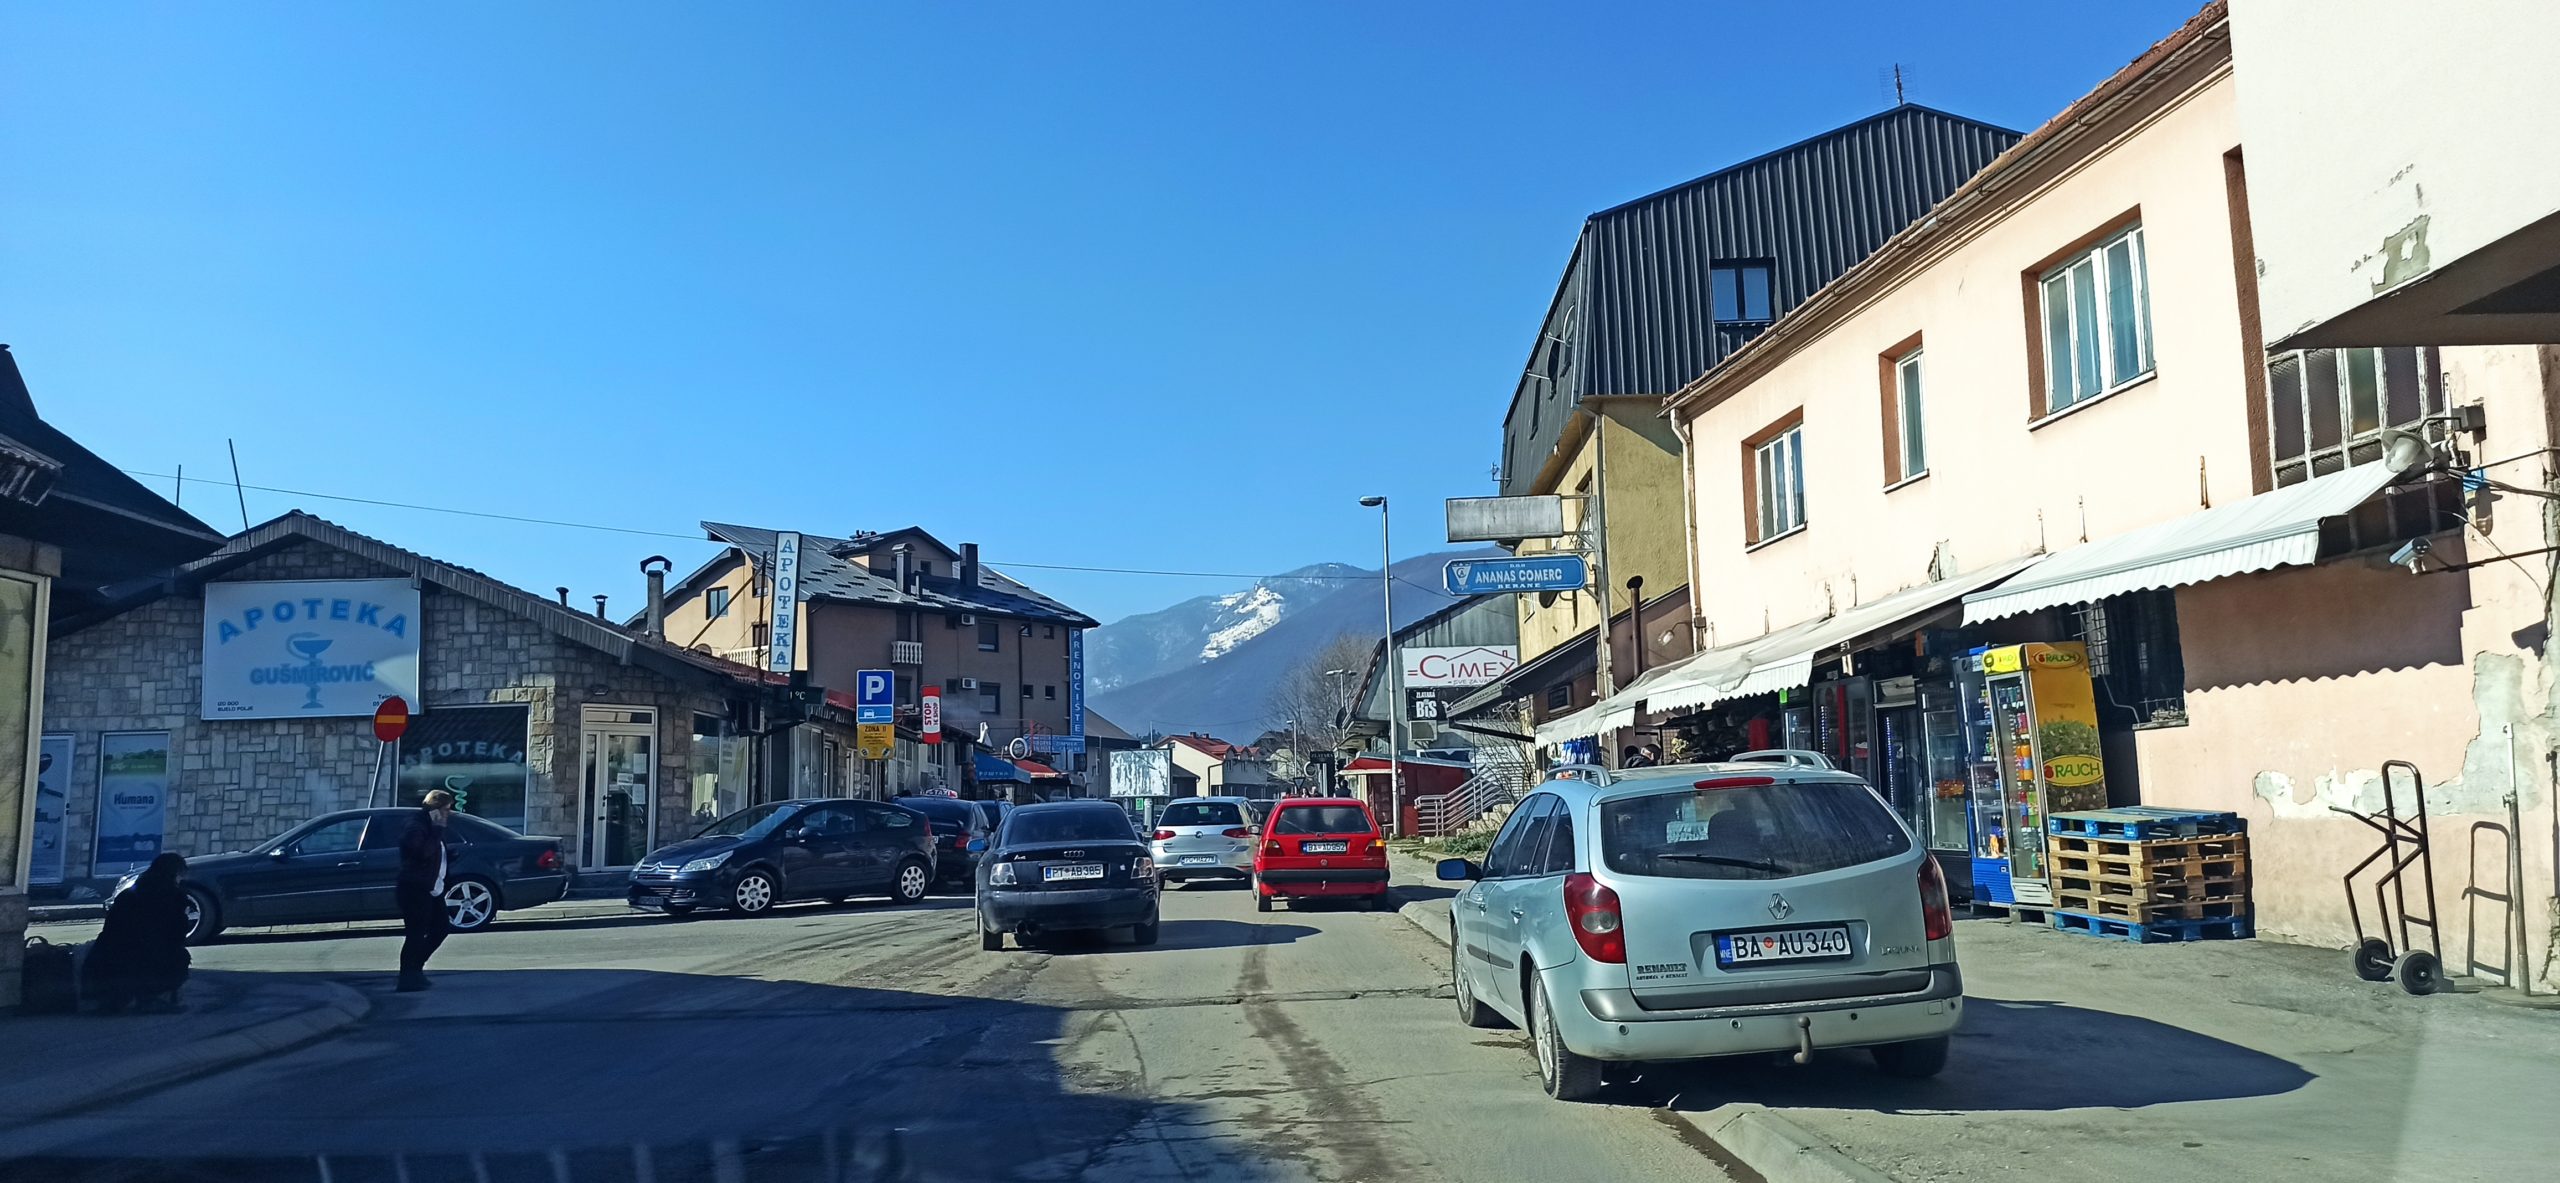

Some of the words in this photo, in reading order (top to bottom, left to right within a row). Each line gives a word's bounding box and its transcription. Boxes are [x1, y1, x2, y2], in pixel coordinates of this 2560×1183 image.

[1475, 571, 1516, 583] ANANAS
[1519, 568, 1562, 581] COMERC
[773, 539, 795, 665] APOTEKA
[218, 598, 407, 645] APOTEKA
[1420, 655, 1515, 679] CIMEX
[2045, 652, 2076, 662] RAUCH
[250, 660, 375, 685] GUŠMIROVIĆ
[866, 675, 885, 701] P
[924, 703, 932, 726] STOP
[404, 741, 523, 771] APOTEKA
[2055, 763, 2101, 777] RAUCH
[114, 792, 154, 805] Humana
[1053, 867, 1064, 877] PT
[1734, 935, 1763, 958] BA
[1779, 930, 1846, 955] AU340
[1637, 963, 1688, 974] RENAULT
